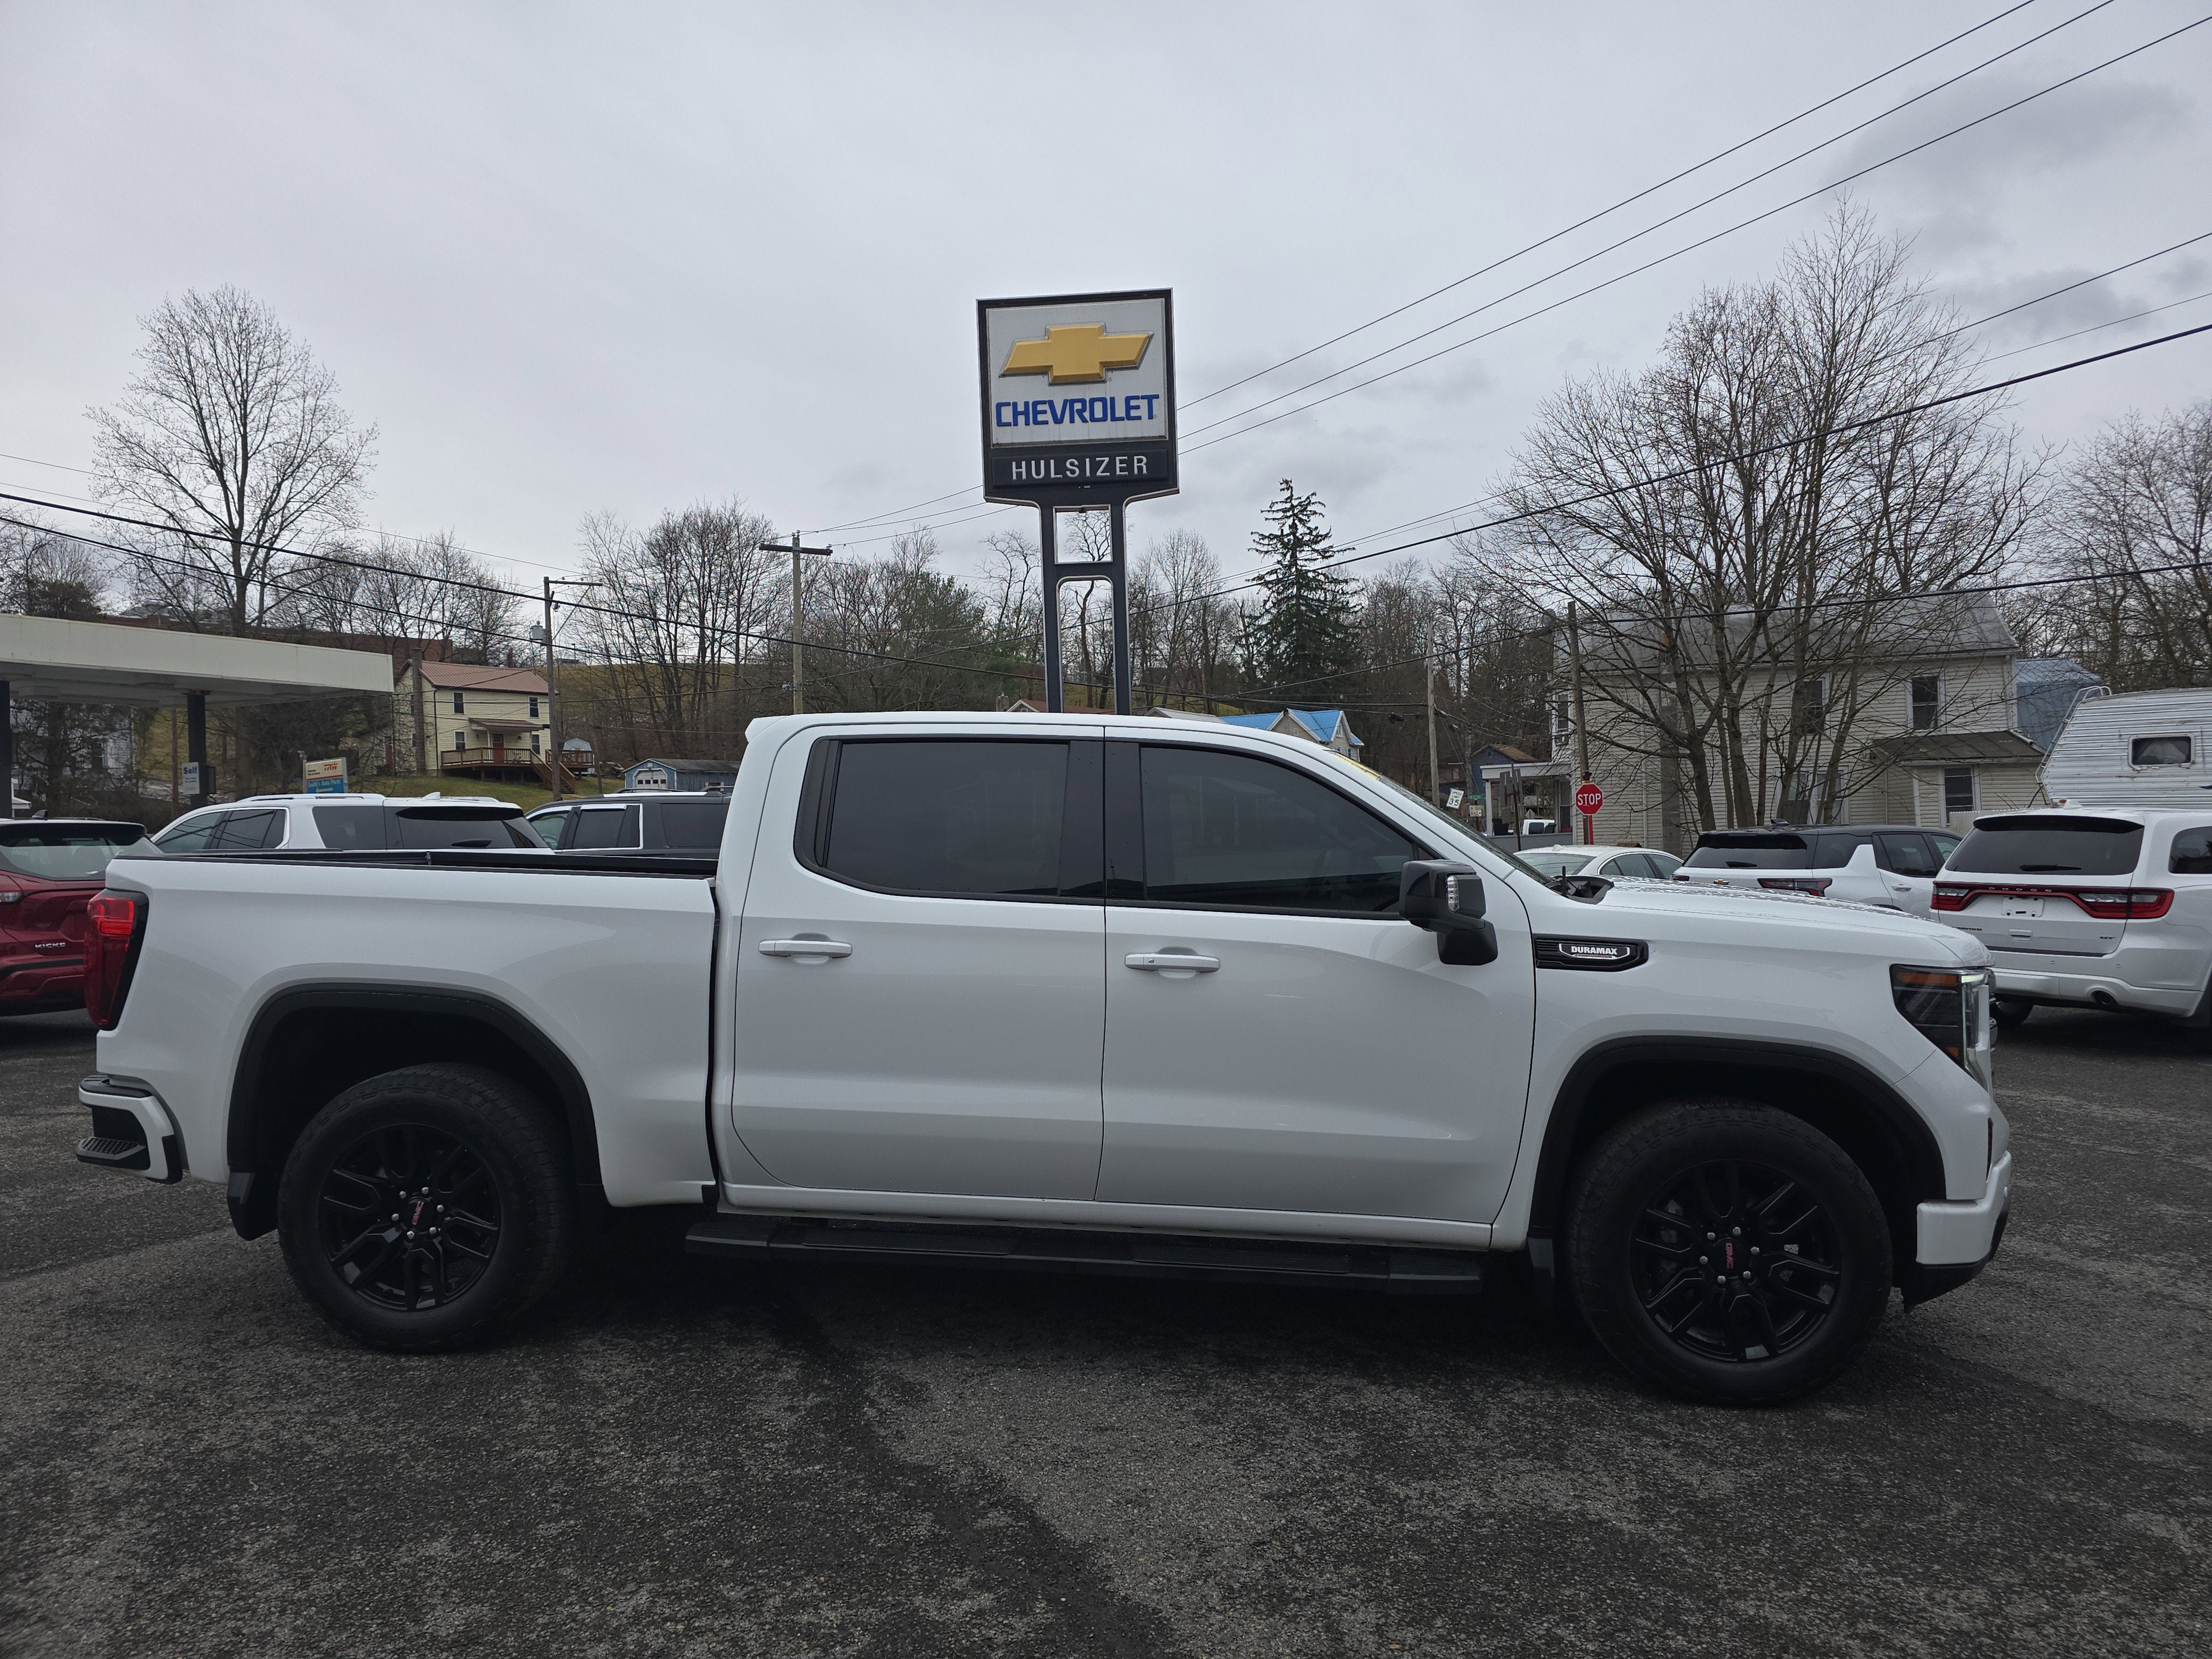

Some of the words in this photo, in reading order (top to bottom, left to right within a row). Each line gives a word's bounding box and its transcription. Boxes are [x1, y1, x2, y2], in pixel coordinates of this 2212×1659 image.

[995, 394, 1159, 427] CHEVROLET
[1012, 455, 1148, 480] HULSIZER
[1578, 793, 1601, 806] STOP
[1571, 946, 1617, 955] DURAMAX
[411, 1200, 424, 1225] GMC
[1726, 1242, 1734, 1269] GMC
